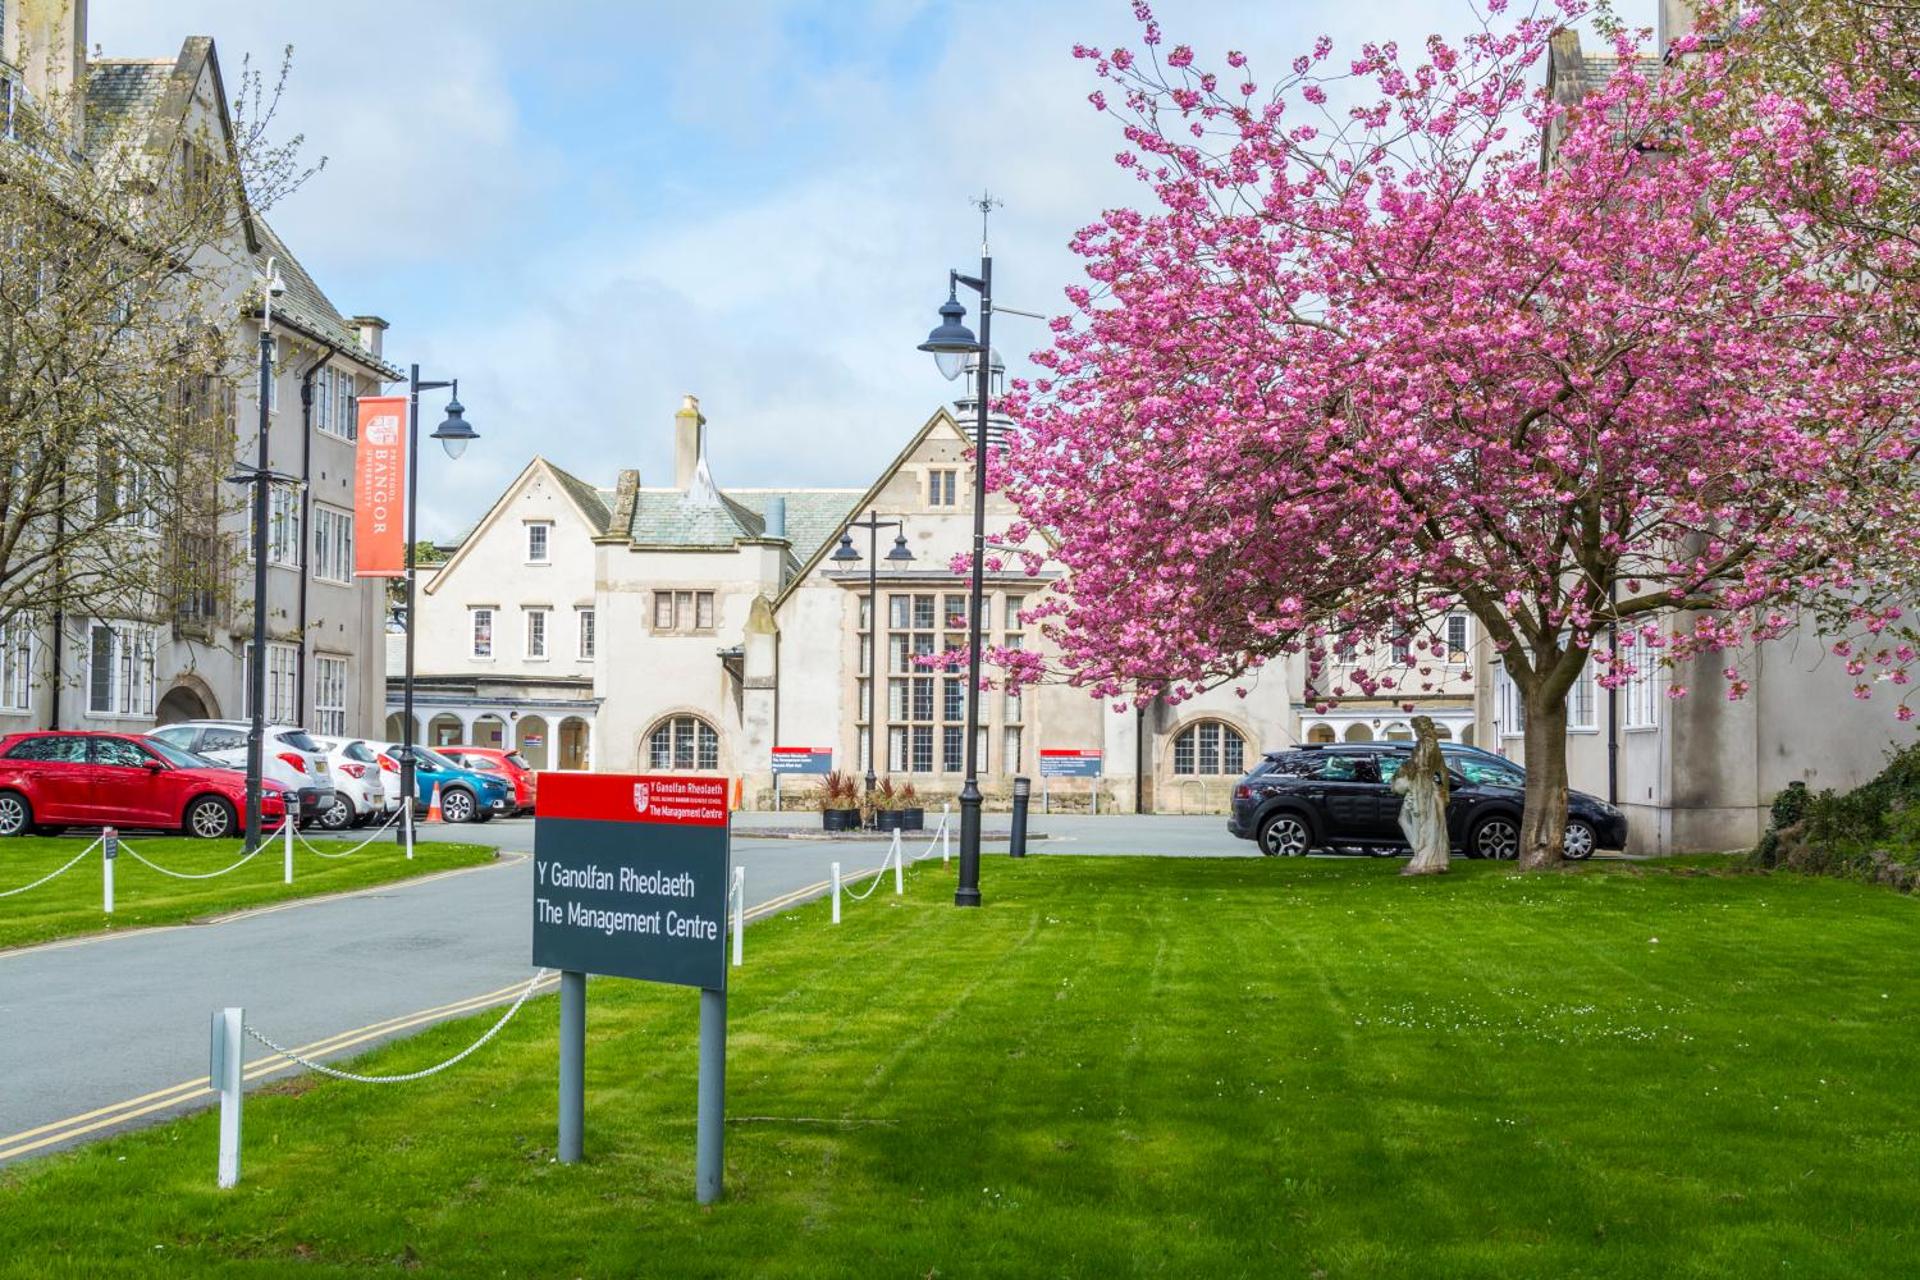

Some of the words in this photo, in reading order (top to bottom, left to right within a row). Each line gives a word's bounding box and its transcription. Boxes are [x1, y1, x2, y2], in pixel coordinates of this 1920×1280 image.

[374, 450, 388, 534] BANGOR
[650, 782, 656, 792] Y
[656, 782, 686, 793] Ganolfan
[688, 783, 722, 794] Rheolaeth
[650, 804, 661, 816] The
[662, 805, 701, 819] Management
[702, 807, 722, 818] Centre
[537, 861, 547, 884] Y
[552, 862, 613, 890] Ganolfan
[620, 866, 694, 898] Rheolaeth
[537, 898, 562, 924] The
[568, 902, 660, 936] Management
[666, 910, 718, 940] Centre
